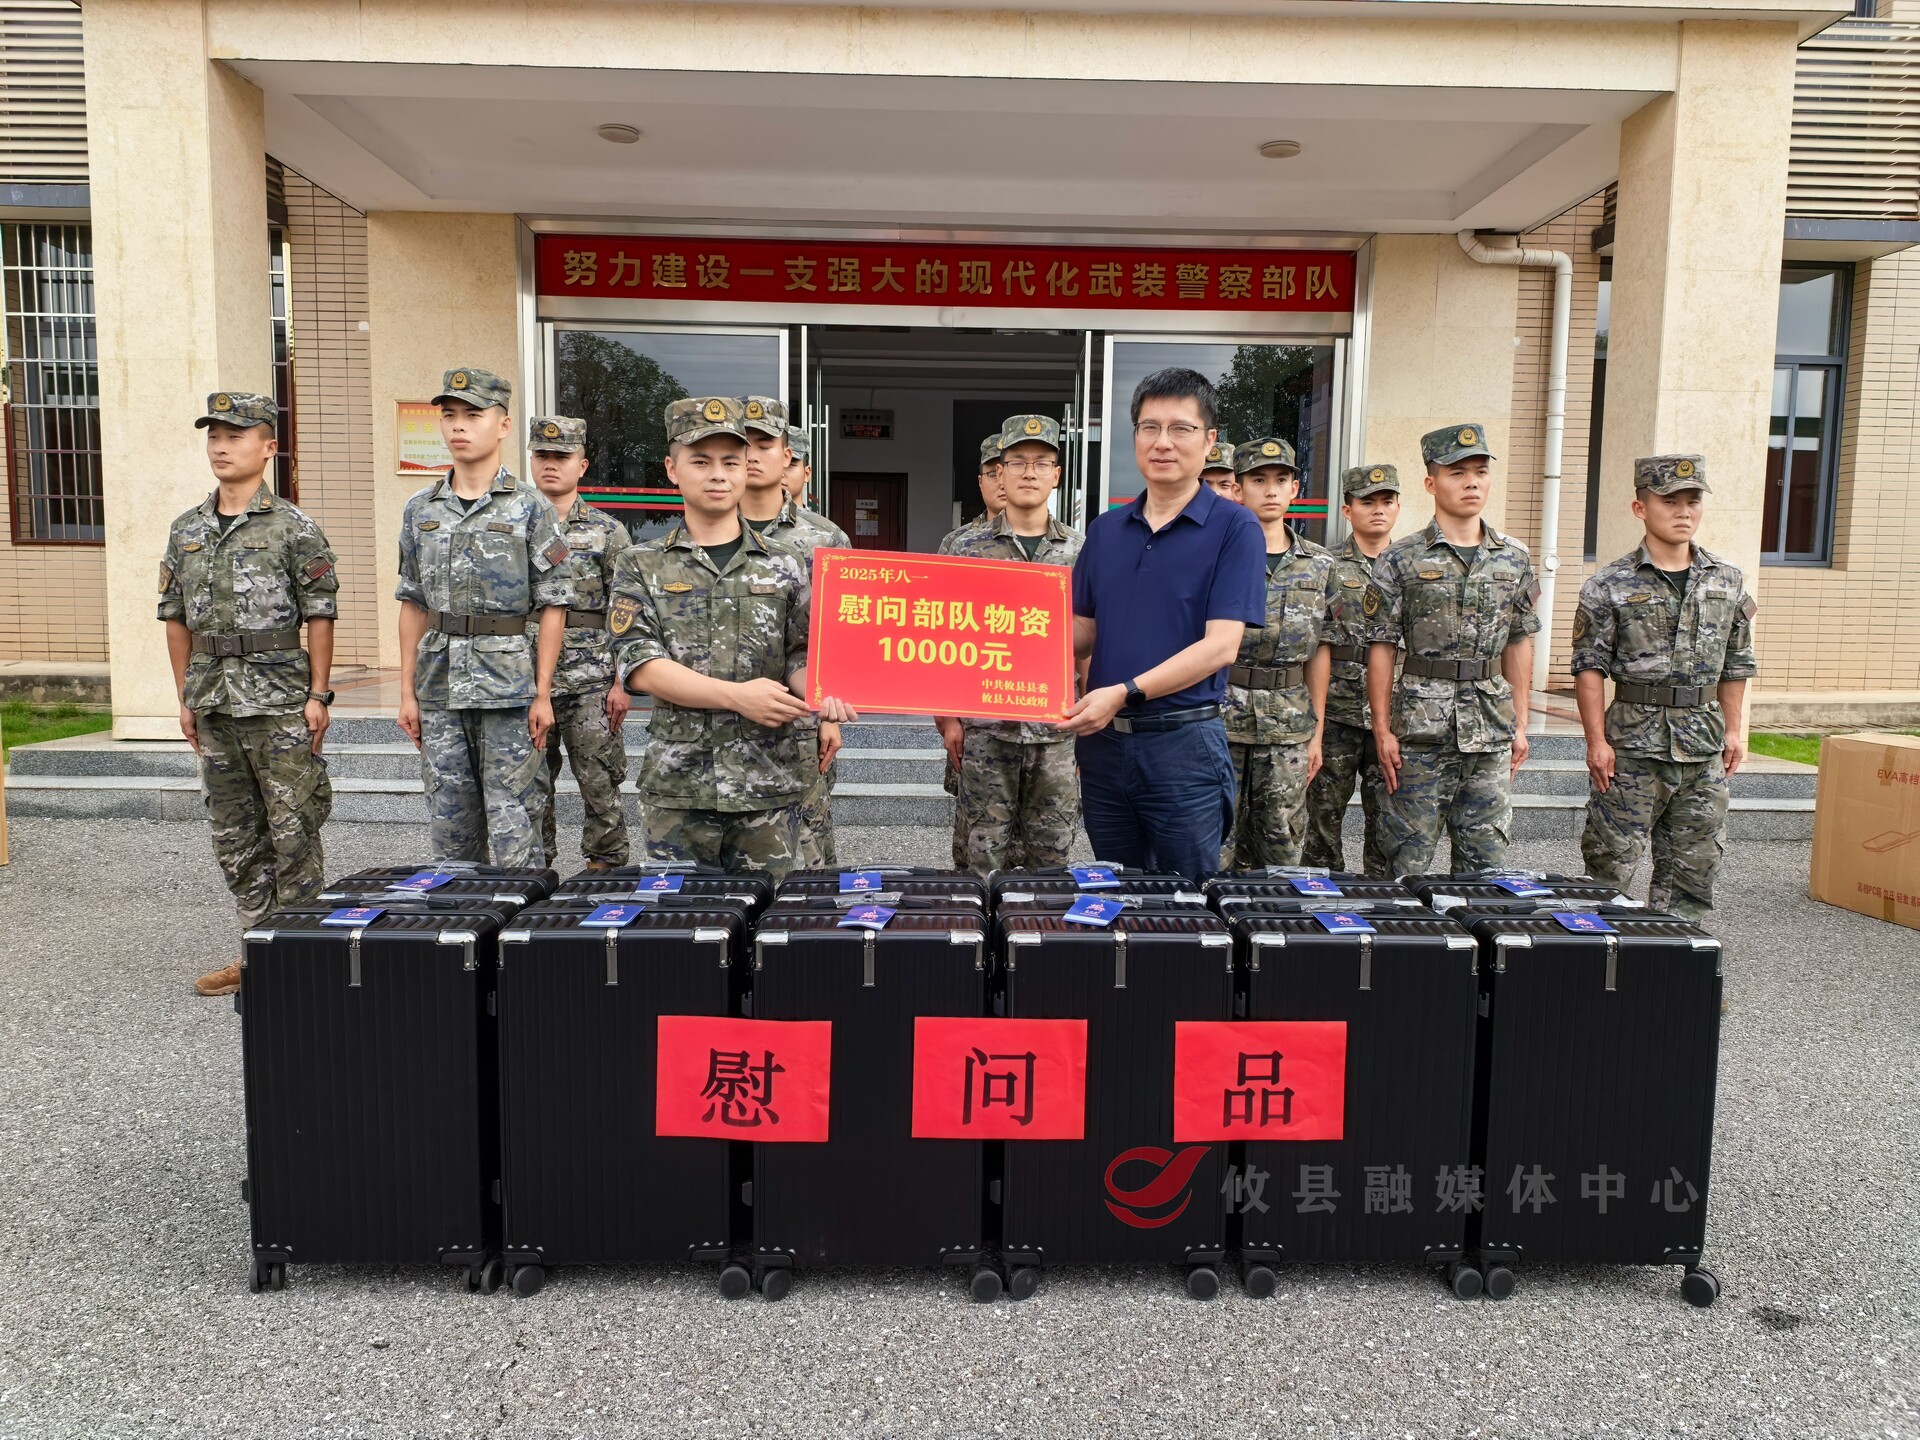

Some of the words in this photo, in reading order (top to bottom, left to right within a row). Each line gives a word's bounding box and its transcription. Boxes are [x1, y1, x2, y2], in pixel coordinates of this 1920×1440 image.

[563, 250, 1339, 301] 努力建设一支强大的现代化武装警察部队
[839, 567, 929, 584] 2025年八一
[838, 594, 1051, 638] 慰问部队物资
[878, 637, 1013, 672] 10000元
[981, 678, 1049, 694] 中共攸县县委
[981, 693, 1049, 708] 攸县人民政府
[699, 1048, 785, 1127] 慰
[962, 1047, 1038, 1126] 问
[1222, 1050, 1295, 1128] 品
